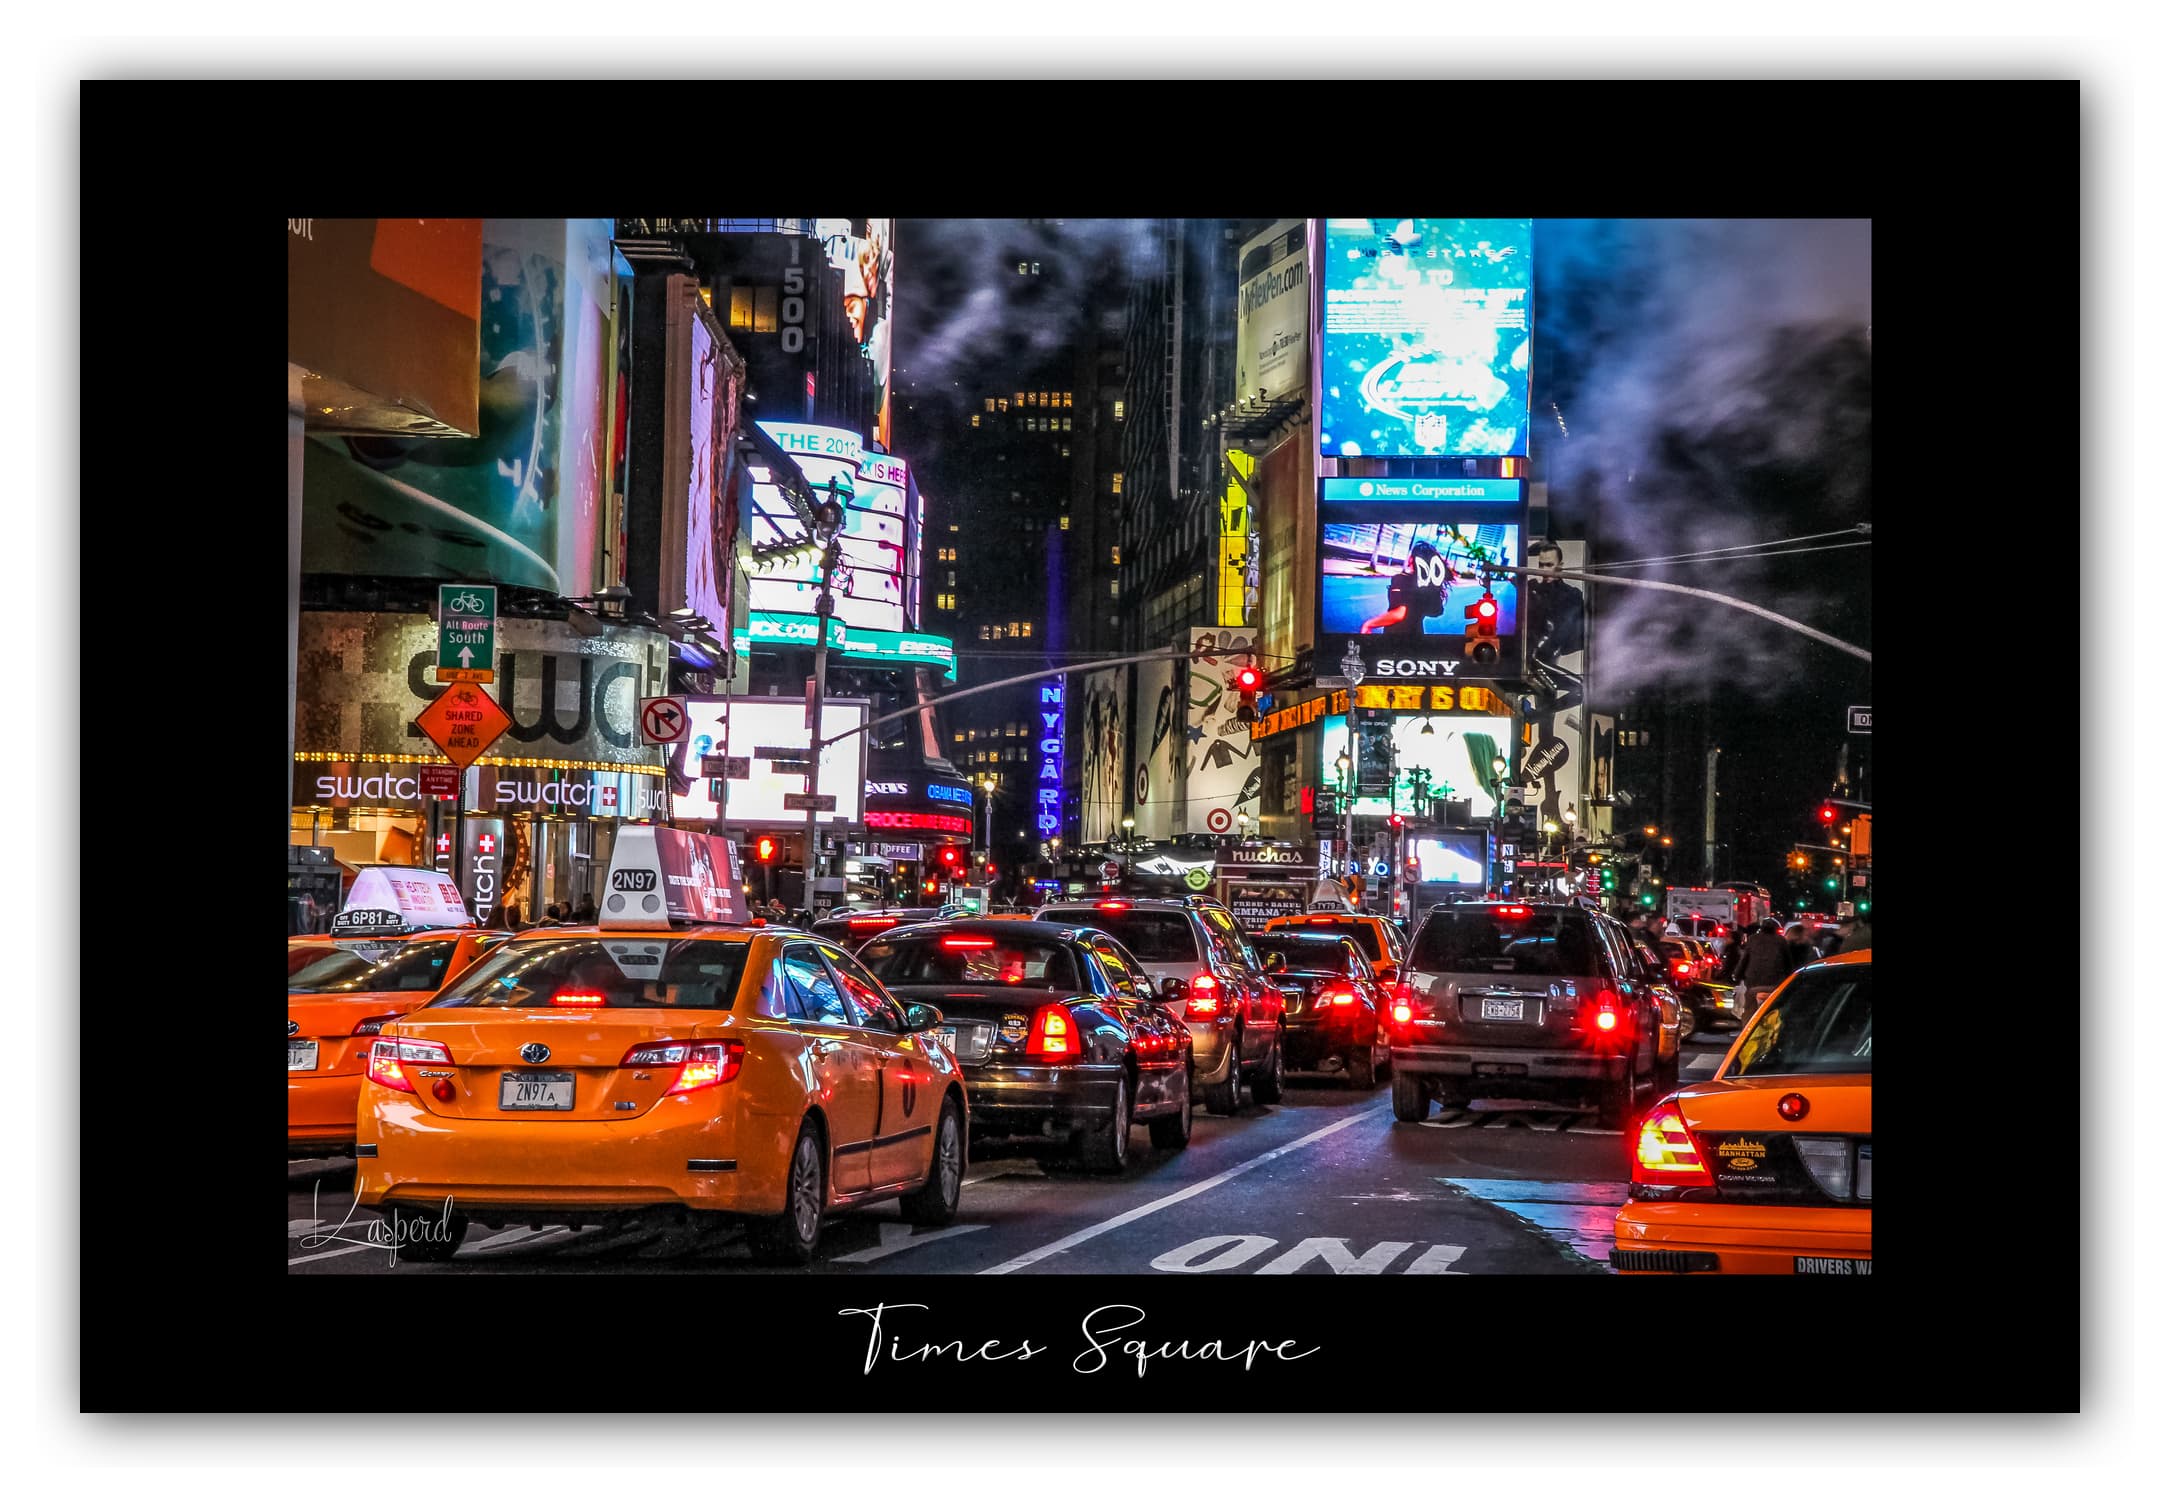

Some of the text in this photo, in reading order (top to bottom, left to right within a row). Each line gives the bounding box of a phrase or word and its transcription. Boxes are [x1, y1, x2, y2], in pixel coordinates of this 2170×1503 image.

[781, 238, 805, 353] 1500
[775, 433, 820, 451] THE
[1376, 484, 1486, 499] News Corporation
[1415, 554, 1446, 588] DO
[446, 620, 489, 631] Alt Route
[449, 631, 486, 644] South
[1376, 660, 1460, 677] SONY
[445, 710, 484, 722] SHARED
[451, 723, 476, 735] ZONE
[447, 737, 481, 748] AHEAD
[495, 779, 594, 806] swatch
[1232, 847, 1304, 864] nuchas
[613, 872, 655, 890] 2N97
[473, 854, 495, 926] atch
[352, 911, 383, 925] 6P81
[1718, 1150, 1766, 1158] MANHATTAN
[1797, 1257, 1852, 1275] DRIVERS
